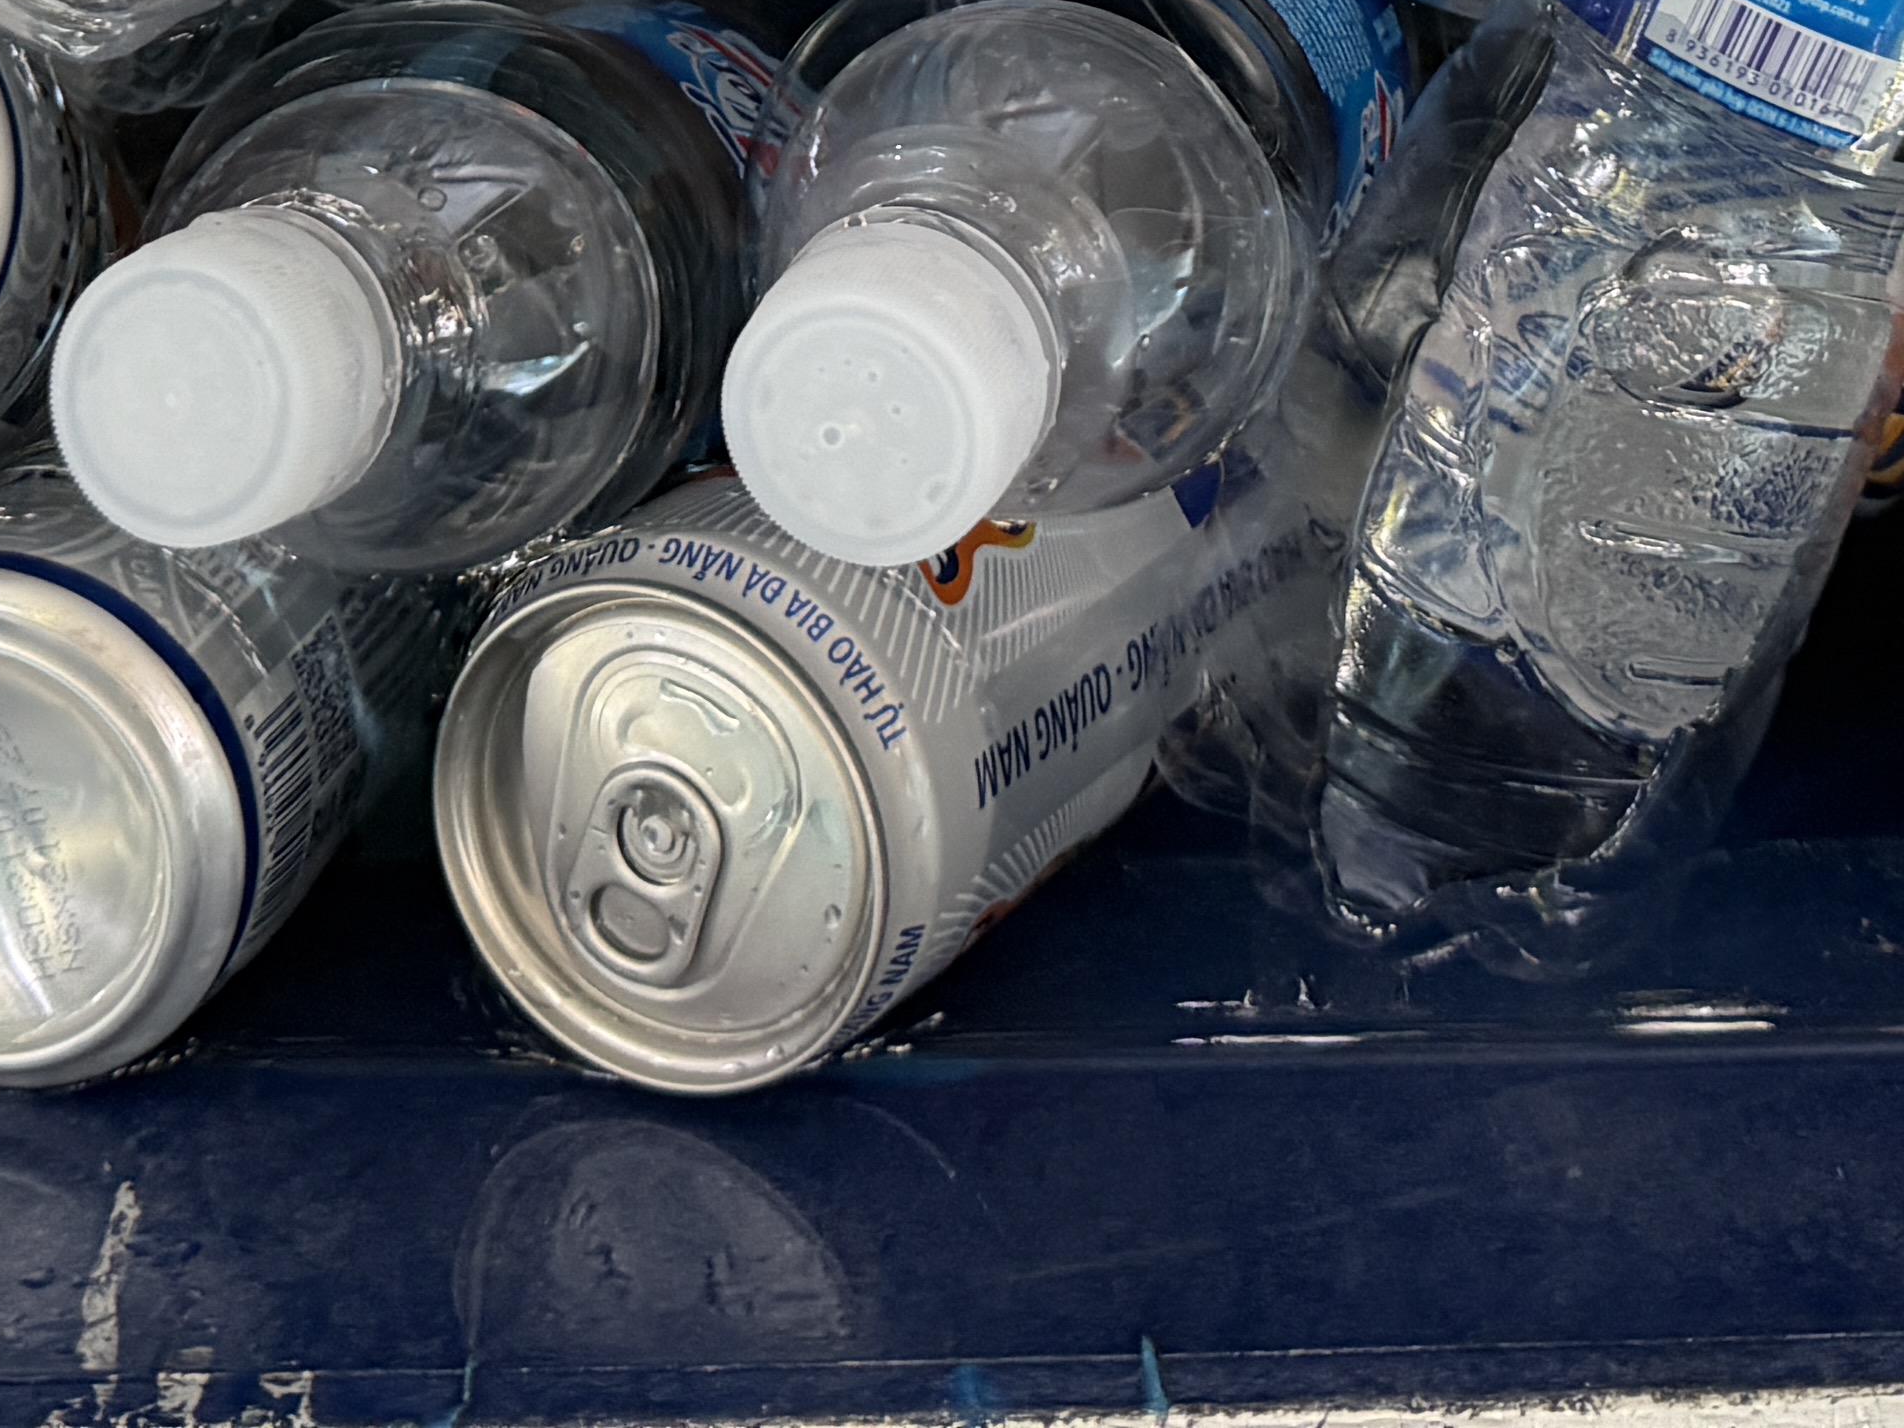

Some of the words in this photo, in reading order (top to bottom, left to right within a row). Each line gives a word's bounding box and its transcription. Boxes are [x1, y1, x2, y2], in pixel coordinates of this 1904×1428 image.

[1665, 27, 1678, 43] 8
[1684, 39, 1761, 87] 936193
[547, 536, 640, 584] QUẢNG
[658, 536, 743, 585] NẴNG
[741, 566, 794, 608] ĐÀ
[785, 601, 838, 645] BIA
[827, 638, 887, 703] HÀO
[864, 701, 910, 752] TỰ
[1033, 664, 1113, 756] QUẢNG
[974, 735, 1033, 809] NAM
[879, 923, 926, 988] NAM
